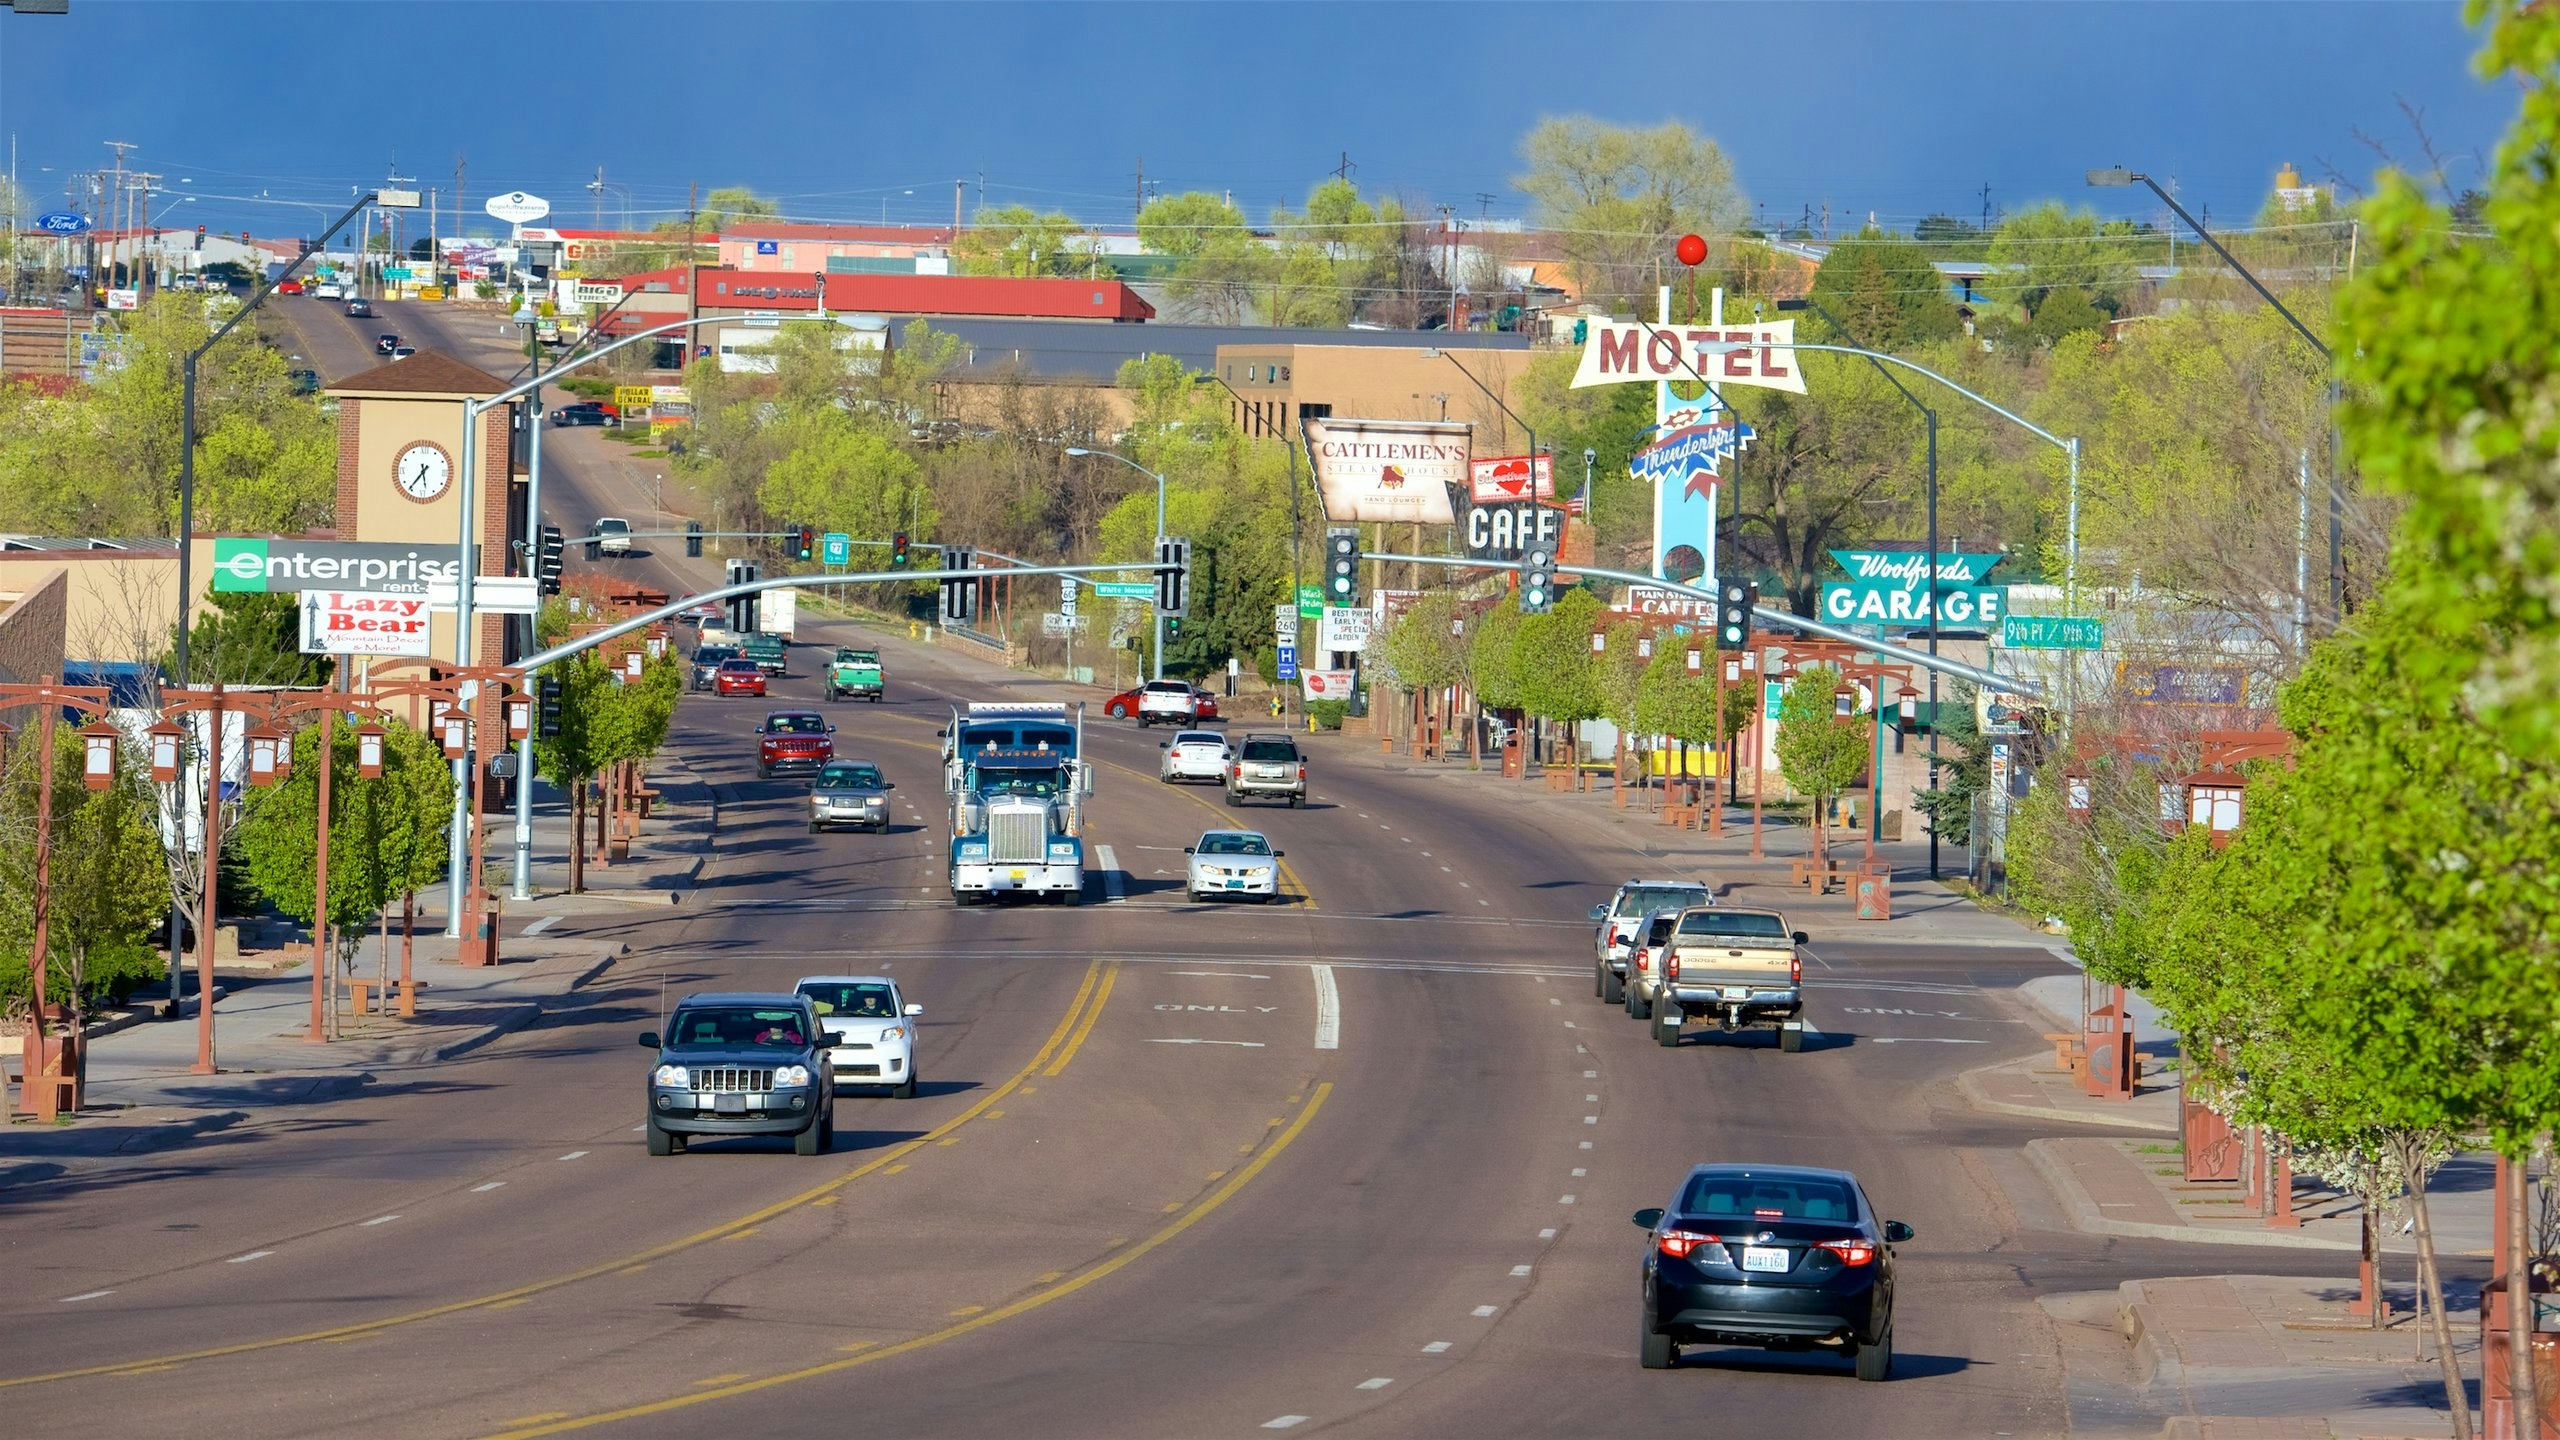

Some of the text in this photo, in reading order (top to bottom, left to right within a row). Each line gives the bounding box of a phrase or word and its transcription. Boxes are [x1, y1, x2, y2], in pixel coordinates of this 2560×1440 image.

[47, 215, 79, 229] Ford
[567, 245, 613, 259] GAS
[578, 286, 604, 294] BIG
[1599, 328, 1788, 377] MOTEL
[620, 388, 649, 396] DOLLAR
[618, 396, 651, 404] GENERAL
[1322, 441, 1466, 461] CATTLEMEN'S
[1327, 463, 1459, 476] STEAK HOUSE
[1388, 496, 1421, 504] LOUNGE
[832, 544, 841, 552] 77
[1100, 585, 1122, 594] White
[1063, 590, 1075, 599] 60
[1636, 590, 1665, 599] MAIN
[328, 593, 425, 617] Lazy
[1063, 604, 1075, 613] 77
[1827, 588, 2000, 622] GARAGE
[1278, 606, 1294, 614] EAST
[1331, 609, 1349, 617] BEST
[327, 613, 426, 633] Bear
[1277, 620, 1296, 631] 260
[1334, 617, 1357, 625] EARLY
[2007, 622, 2028, 641] 9th
[2086, 624, 2100, 642] St
[326, 633, 426, 644] Mountain Decor
[364, 644, 401, 652] More!
[1281, 650, 1293, 663] H
[1153, 1004, 1279, 1013] ONLY
[1843, 1006, 1961, 1018] ONLY
